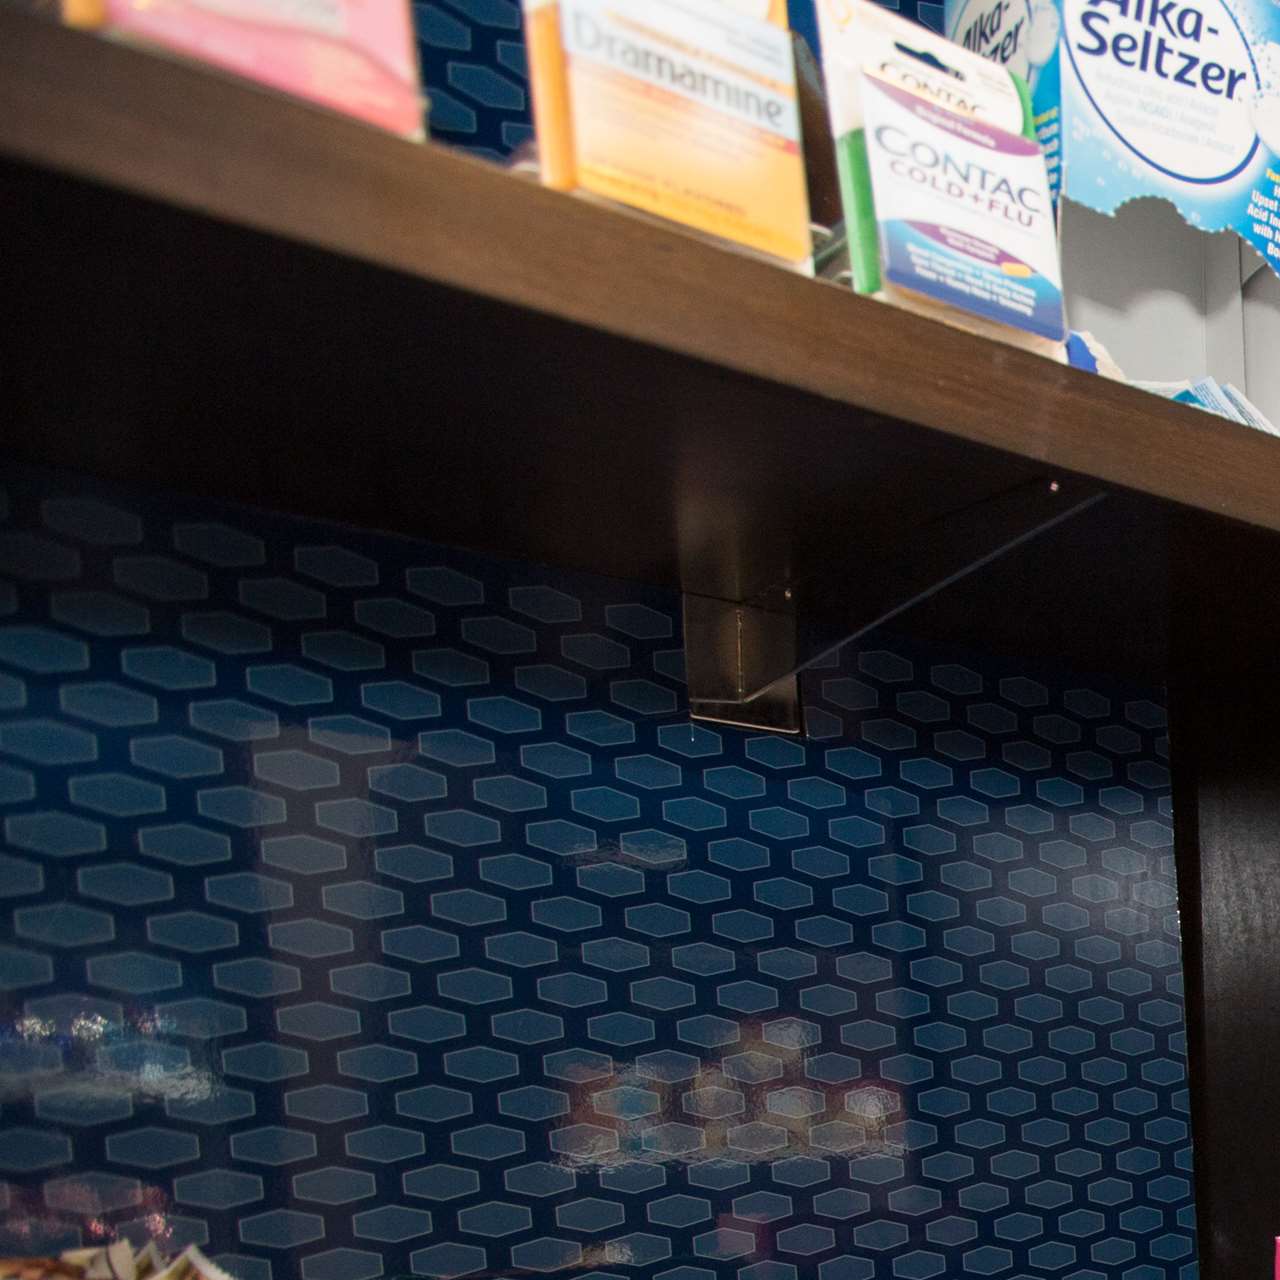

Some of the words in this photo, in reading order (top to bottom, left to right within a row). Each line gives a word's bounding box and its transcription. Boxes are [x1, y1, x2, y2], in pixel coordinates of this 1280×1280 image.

[573, 11, 784, 128] Dramamine
[1077, 10, 1246, 100] Seltzer
[875, 124, 1041, 214] CONTAC
[1247, 204, 1268, 221] Acid
[1251, 190, 1278, 212] Upset
[1253, 224, 1273, 239] with
